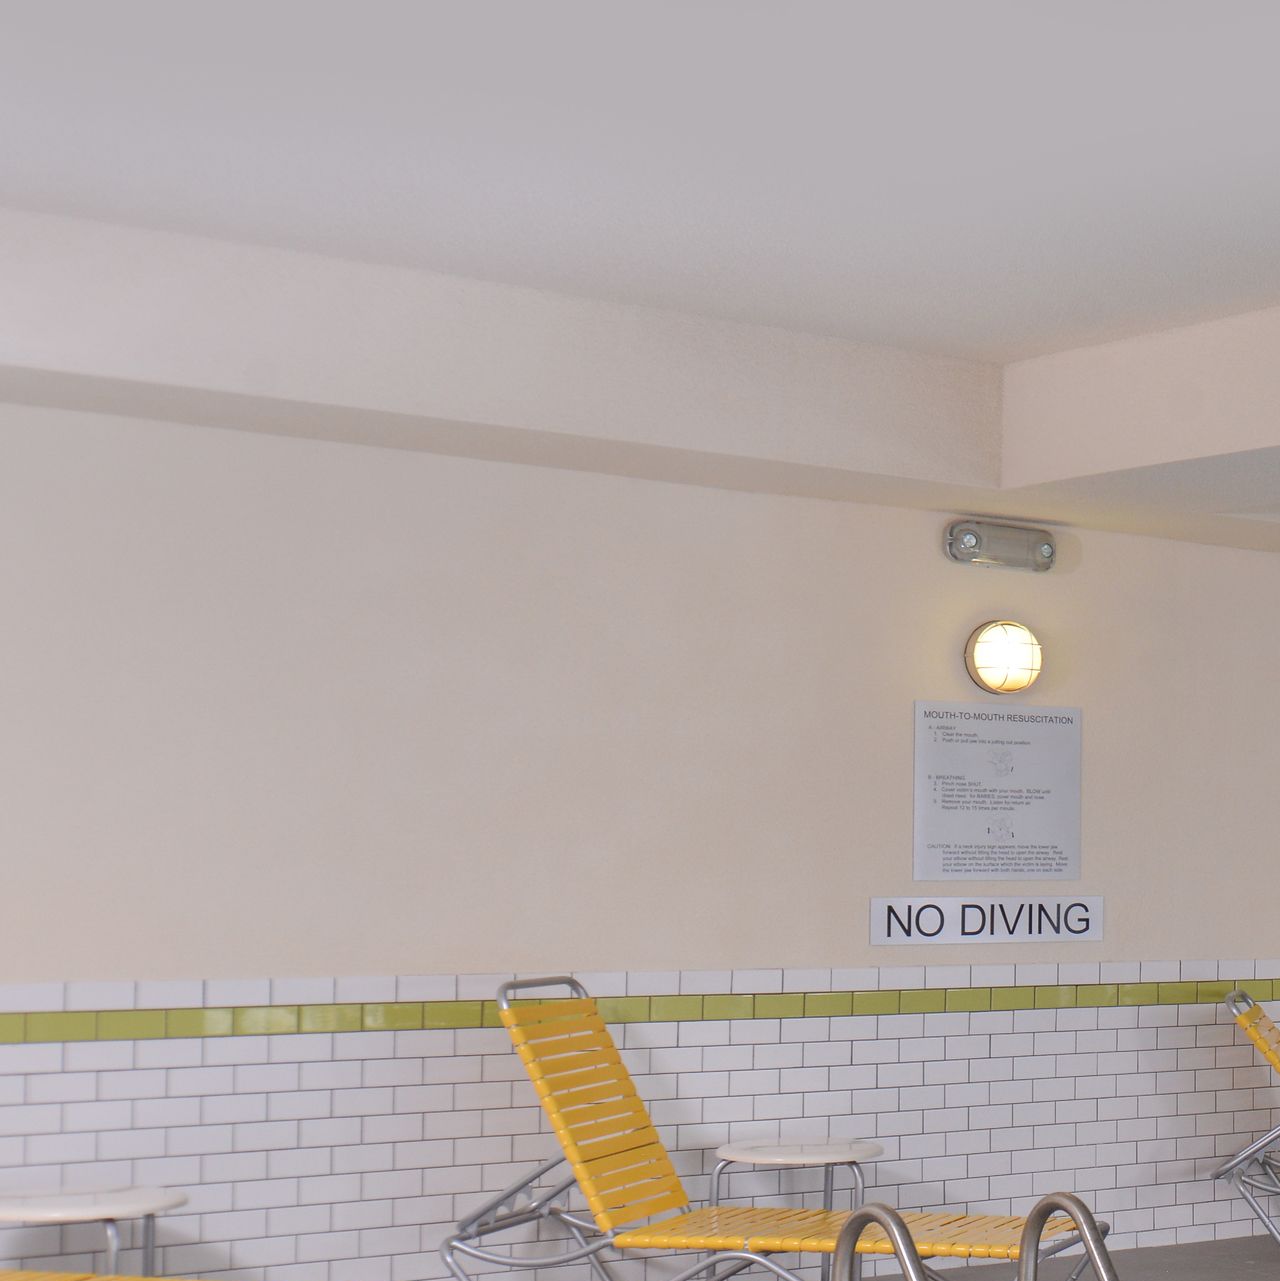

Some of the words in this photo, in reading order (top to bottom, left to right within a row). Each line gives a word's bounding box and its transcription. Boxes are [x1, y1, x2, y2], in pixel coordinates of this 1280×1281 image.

[924, 710, 1004, 721] MOUTH-TO-MOUTH
[1007, 714, 1073, 725] RESUSCITATION
[887, 904, 945, 938] NO
[960, 902, 1090, 936] DIVING
